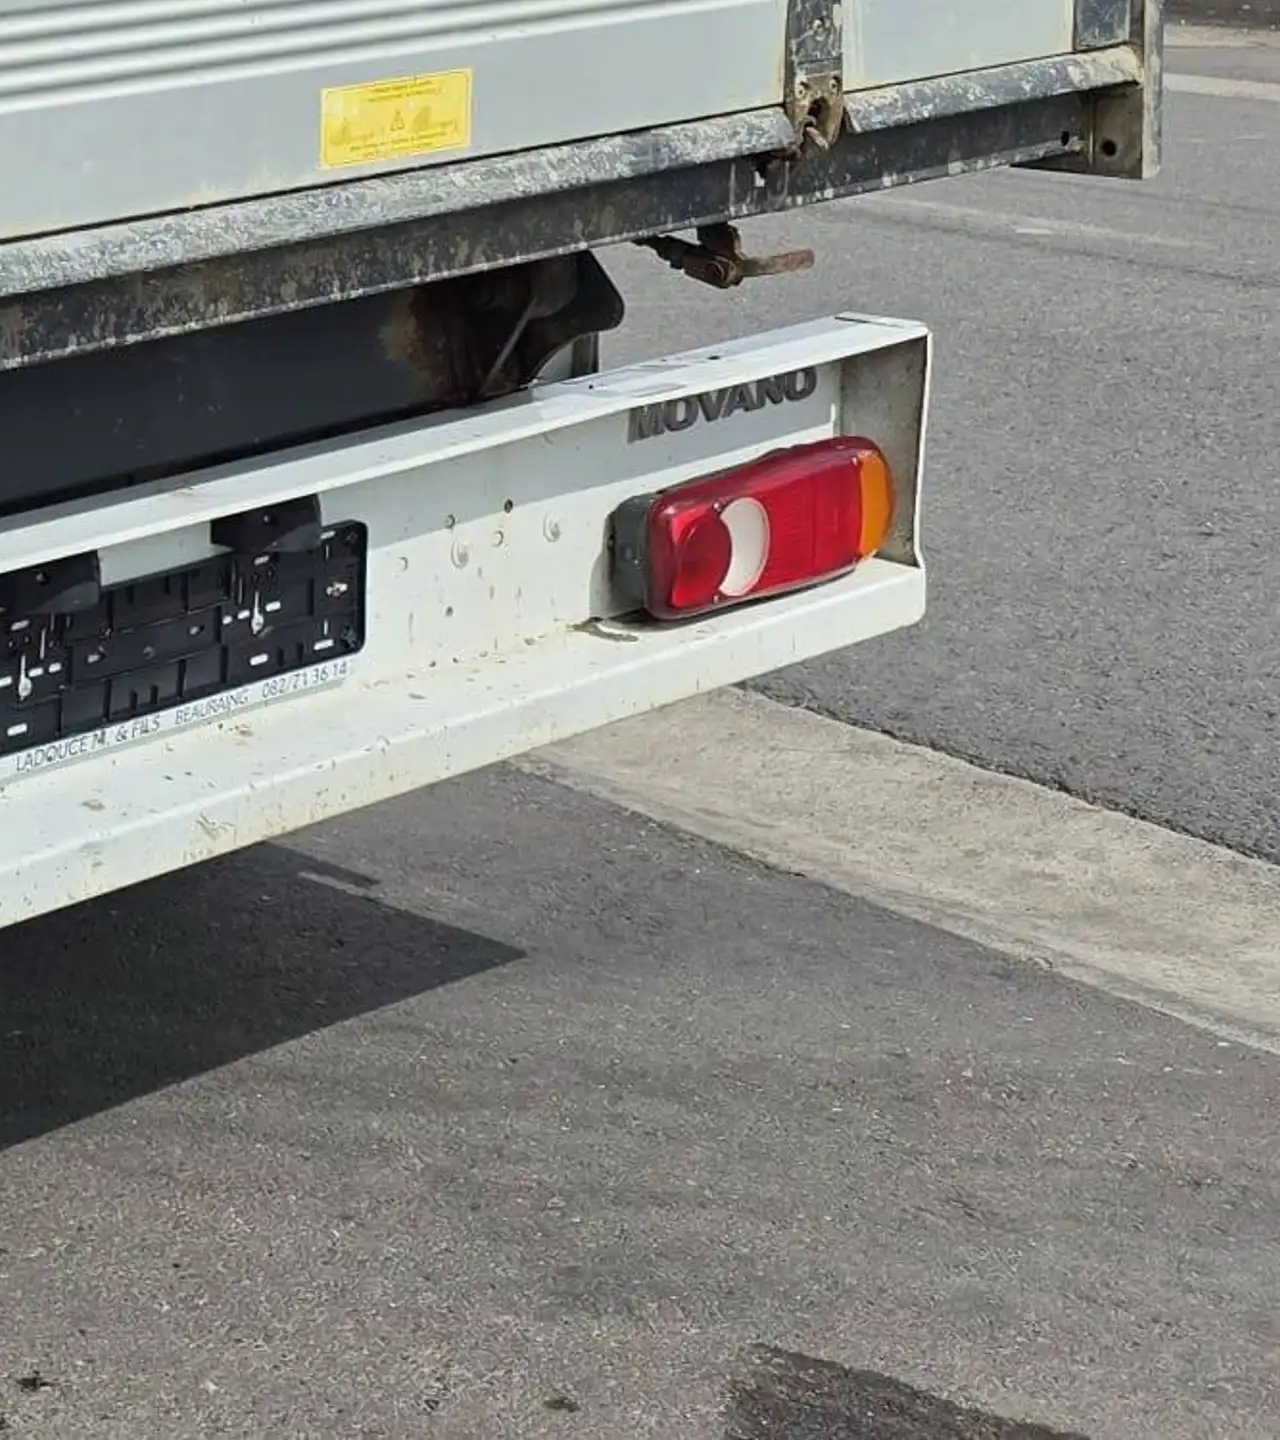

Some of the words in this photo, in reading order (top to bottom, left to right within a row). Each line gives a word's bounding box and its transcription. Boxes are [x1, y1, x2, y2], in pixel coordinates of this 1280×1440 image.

[627, 367, 818, 444] MOVANO
[15, 737, 88, 772] LADOUCE
[115, 727, 129, 743] &
[131, 716, 161, 739] FILS
[174, 689, 250, 726] BEAURAING
